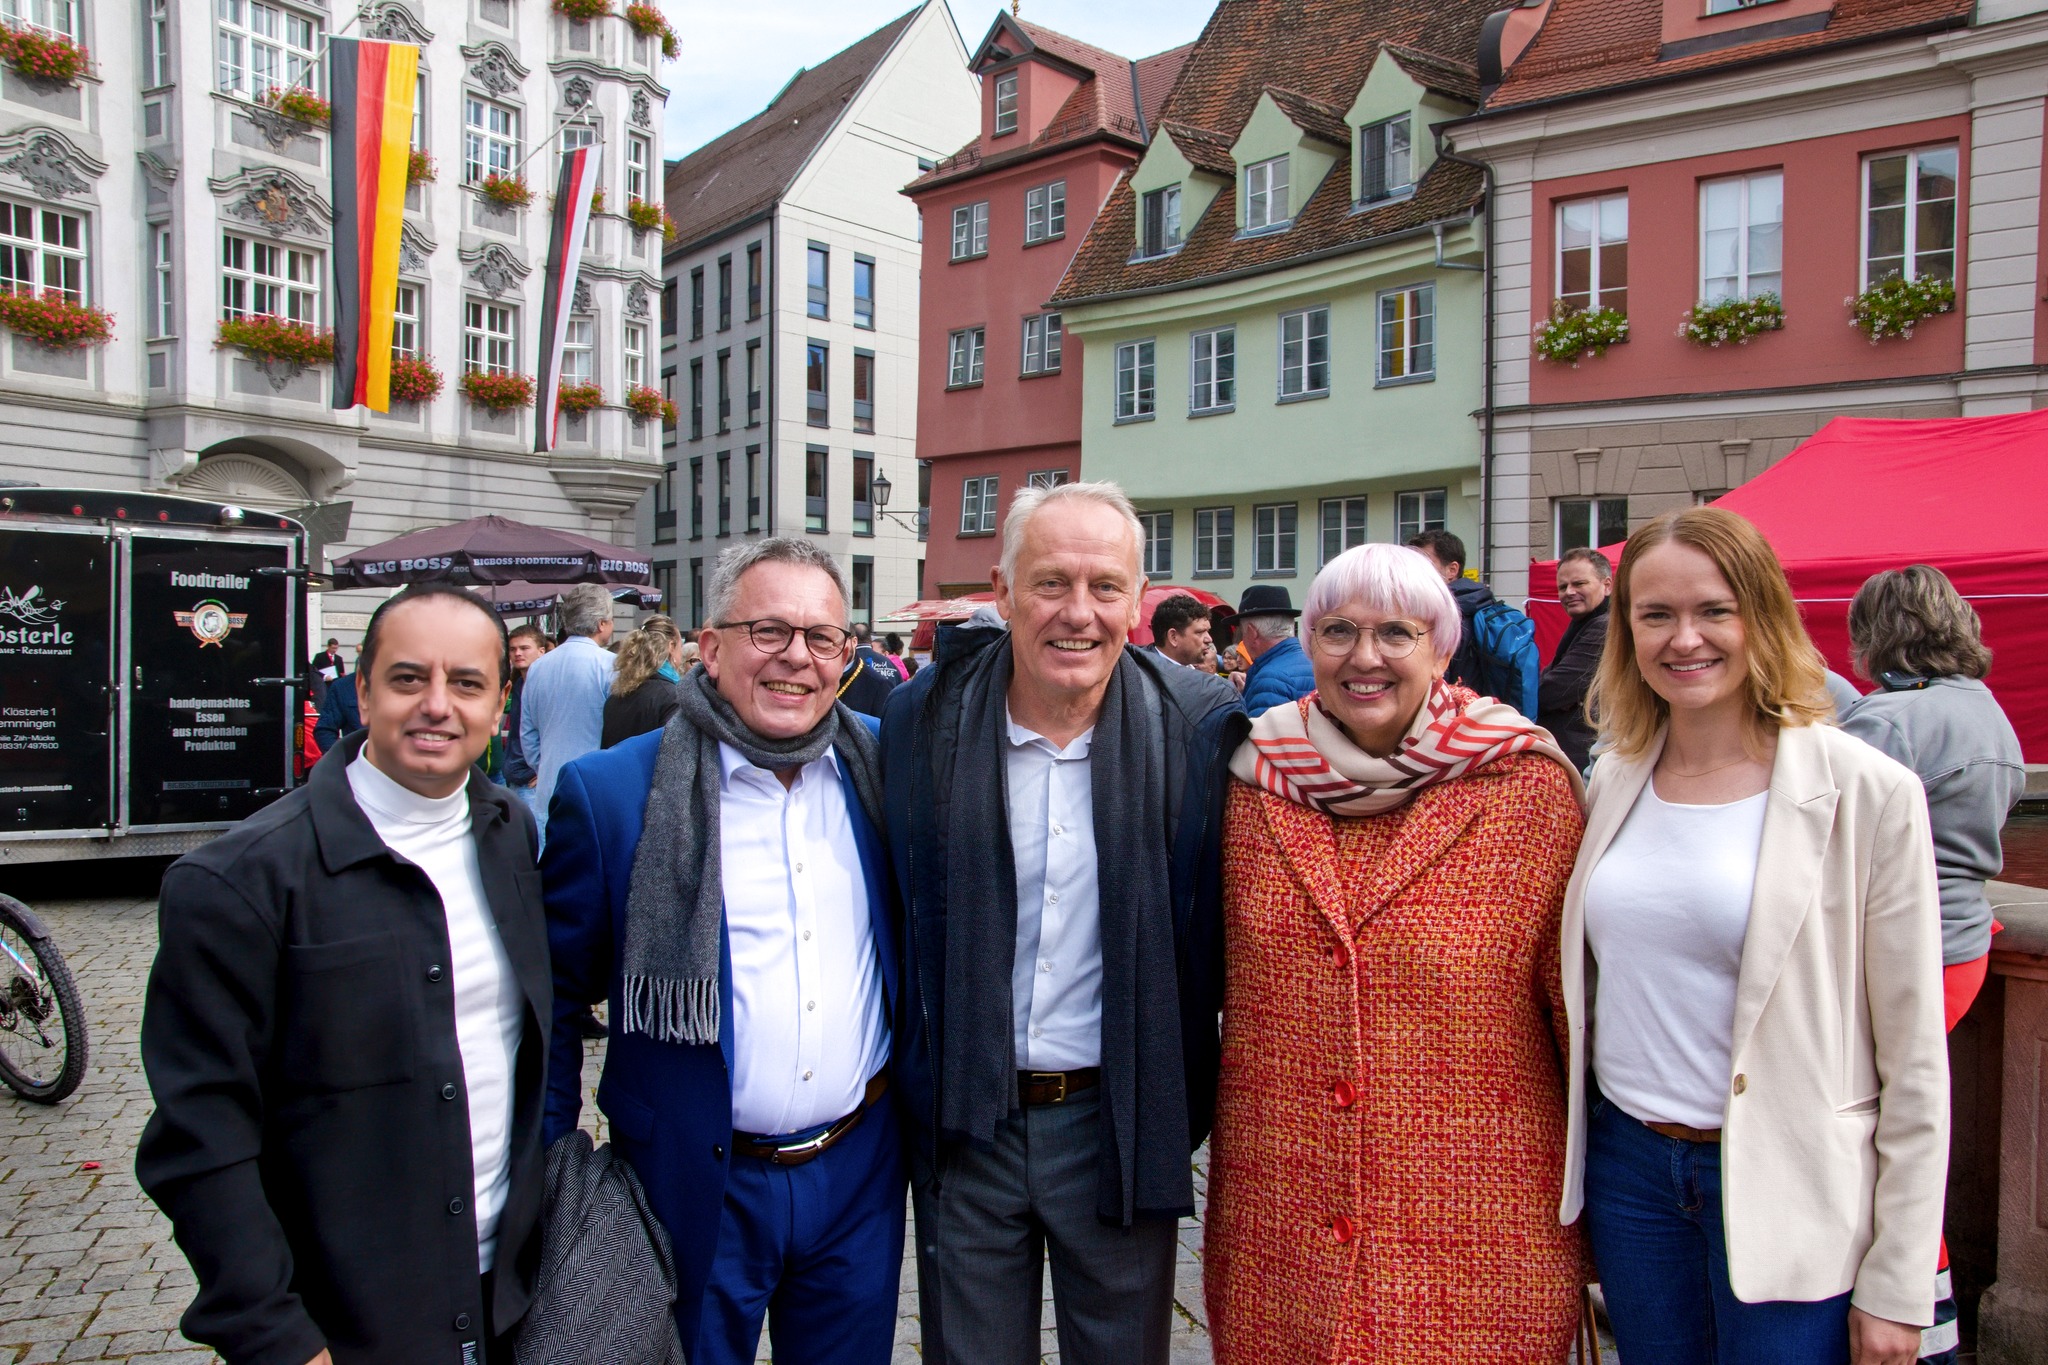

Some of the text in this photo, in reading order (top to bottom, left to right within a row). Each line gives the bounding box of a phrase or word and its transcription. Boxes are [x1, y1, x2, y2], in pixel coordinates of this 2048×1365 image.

[363, 560, 397, 575] BIG
[400, 557, 453, 572] BOSS
[473, 557, 584, 566] BIGBOSS-FOODTRUCK.DE
[600, 559, 623, 572] BIG
[624, 560, 649, 574] BOSS
[170, 571, 251, 590] Foodtrailer
[495, 598, 553, 613] IG BOSS
[169, 697, 251, 710] handgemachtes
[2, 707, 56, 716] Klösterle 1
[195, 712, 225, 723] Essen
[172, 726, 248, 738] aus regionalen
[184, 740, 237, 752] Produkten
